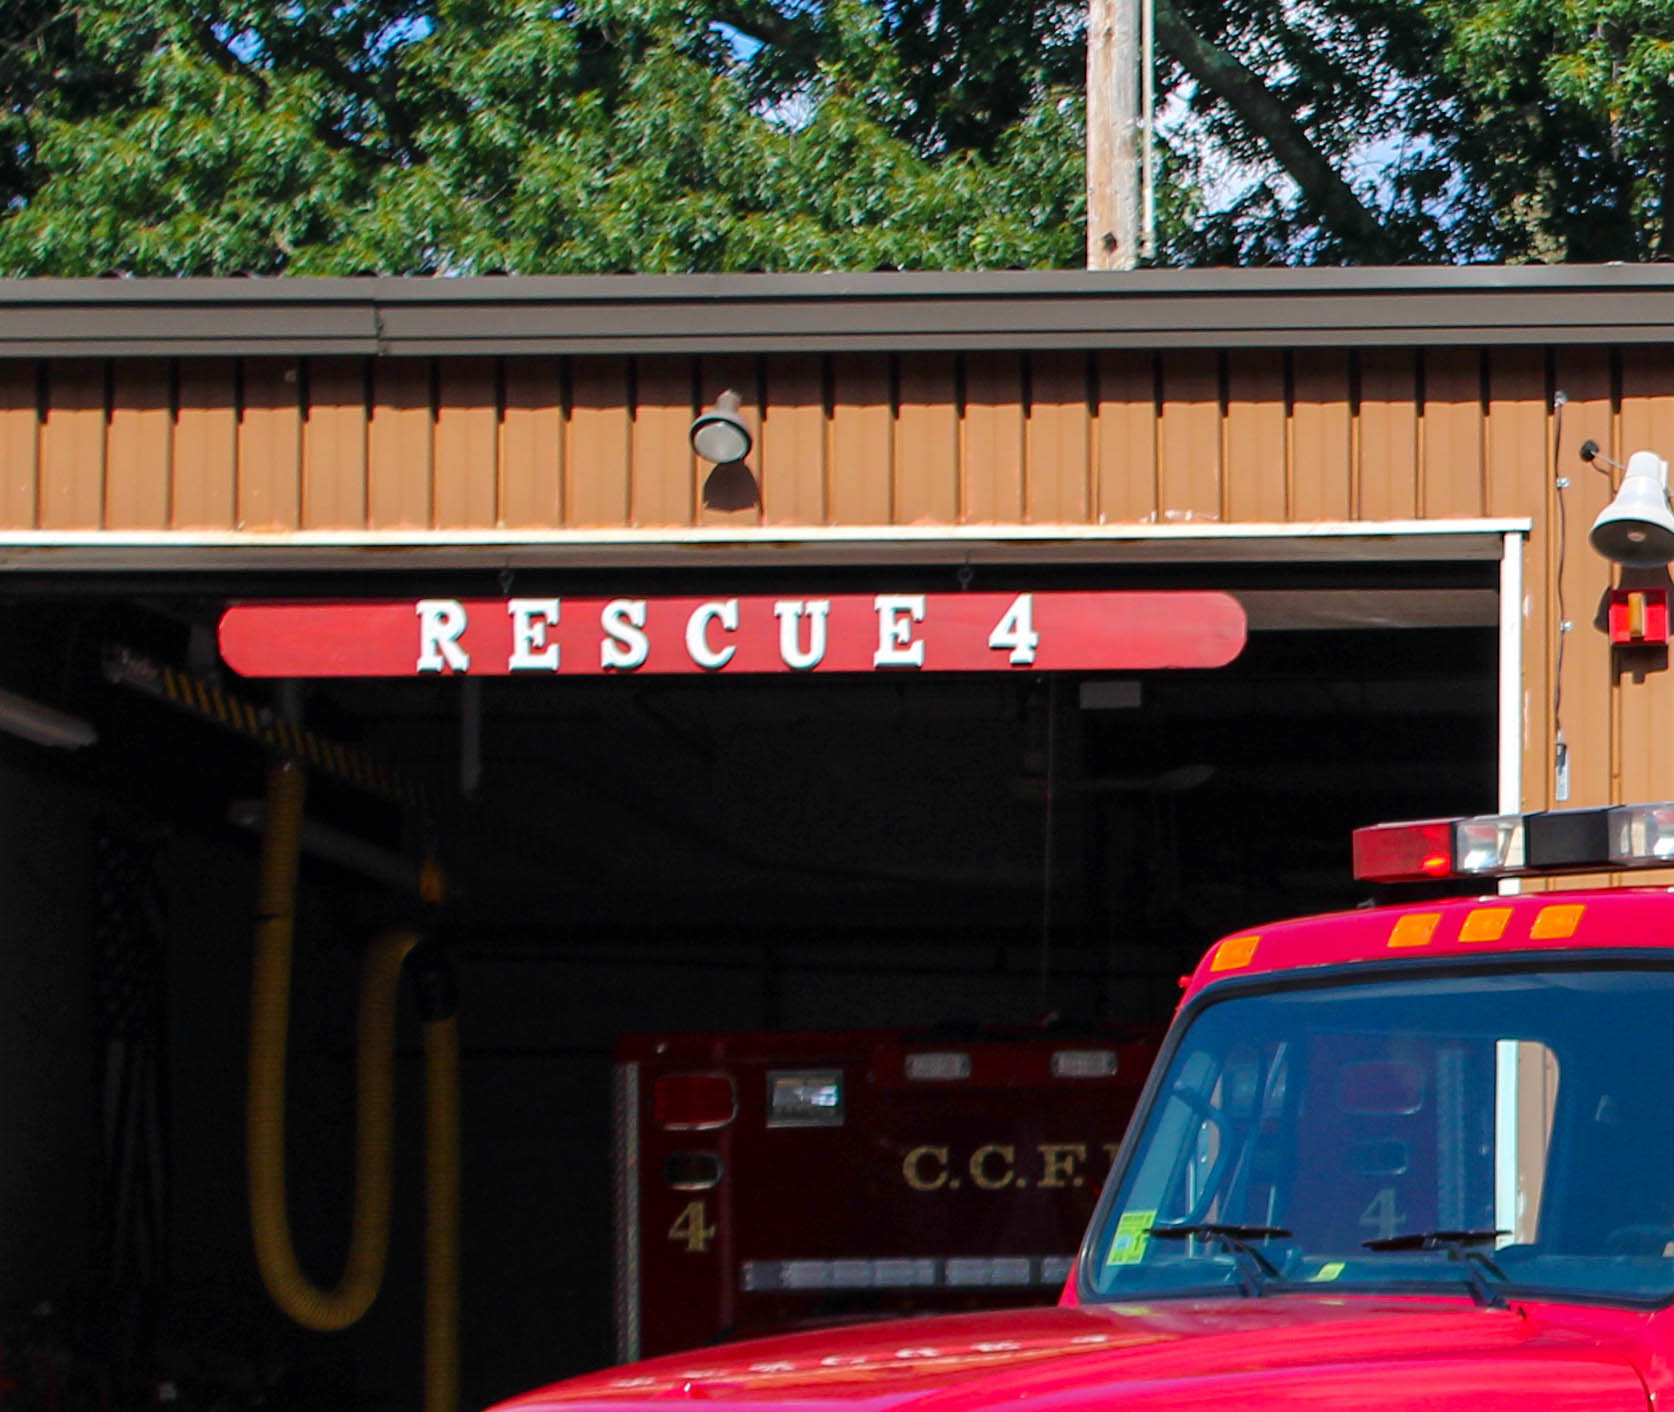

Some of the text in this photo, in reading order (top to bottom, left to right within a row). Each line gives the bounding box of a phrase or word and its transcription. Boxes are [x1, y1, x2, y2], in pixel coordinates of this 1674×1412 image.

[415, 593, 1038, 673] RESCUE 4
[668, 1200, 716, 1253] 4
